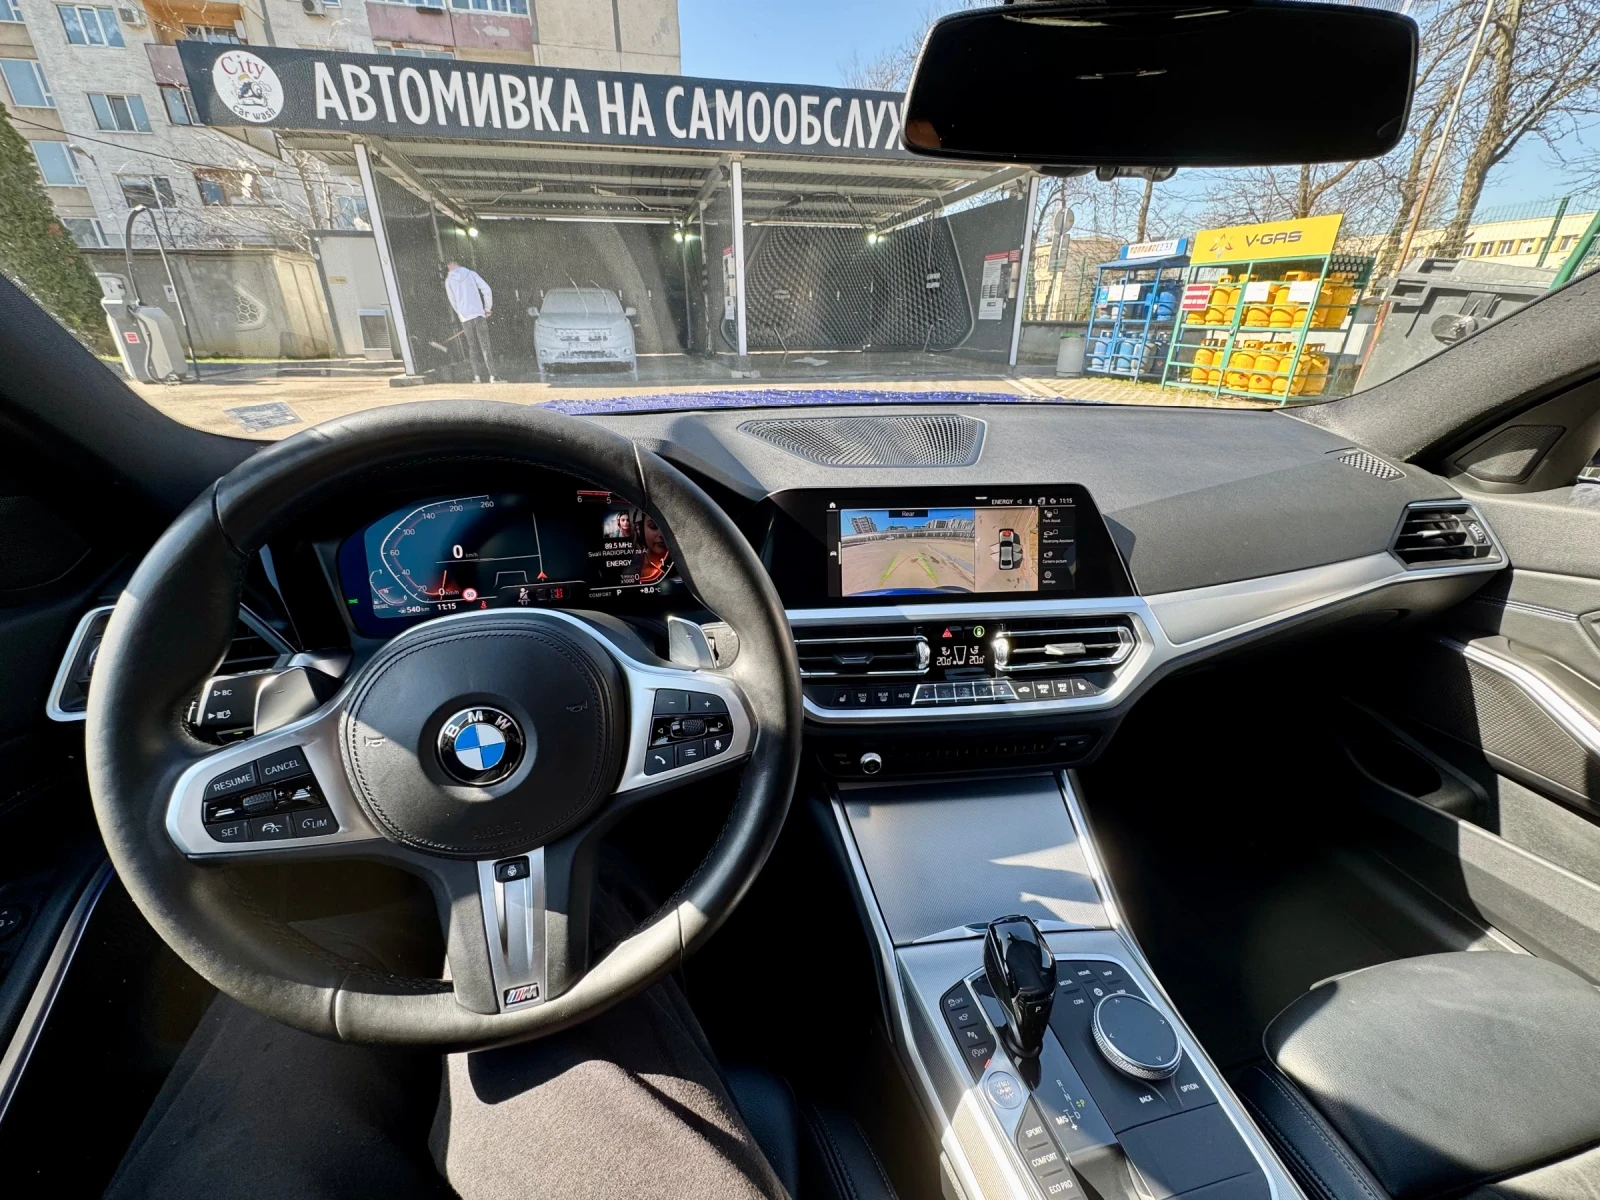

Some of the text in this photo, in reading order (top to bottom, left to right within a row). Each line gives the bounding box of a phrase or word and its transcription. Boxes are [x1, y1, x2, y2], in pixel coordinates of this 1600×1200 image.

[221, 54, 265, 79] City
[315, 61, 590, 133] АВТОМИВКА
[597, 80, 656, 137] НА
[233, 105, 277, 121] car wash
[1245, 230, 1304, 247] V-GAS
[577, 495, 582, 503] 6
[606, 496, 612, 504] 5
[403, 528, 416, 536] 100
[452, 544, 464, 559] 0
[602, 549, 634, 557] RADIOPLAY
[438, 588, 445, 596] 0
[437, 603, 457, 611] 11:15
[445, 710, 512, 738] BMW
[264, 759, 300, 776] CANCEL
[213, 773, 252, 792] RESUME
[312, 818, 328, 829] LIM
[221, 826, 239, 838] SET
[1056, 1079, 1063, 1087] R
[1180, 1083, 1199, 1093] OPTION
[1064, 1093, 1072, 1101] N
[1138, 1094, 1154, 1104] BACK
[1074, 1111, 1081, 1119] D
[1025, 1126, 1043, 1138] SPORT
[1031, 1152, 1057, 1167] COMFORT
[1048, 1179, 1073, 1195] ECO PRO
